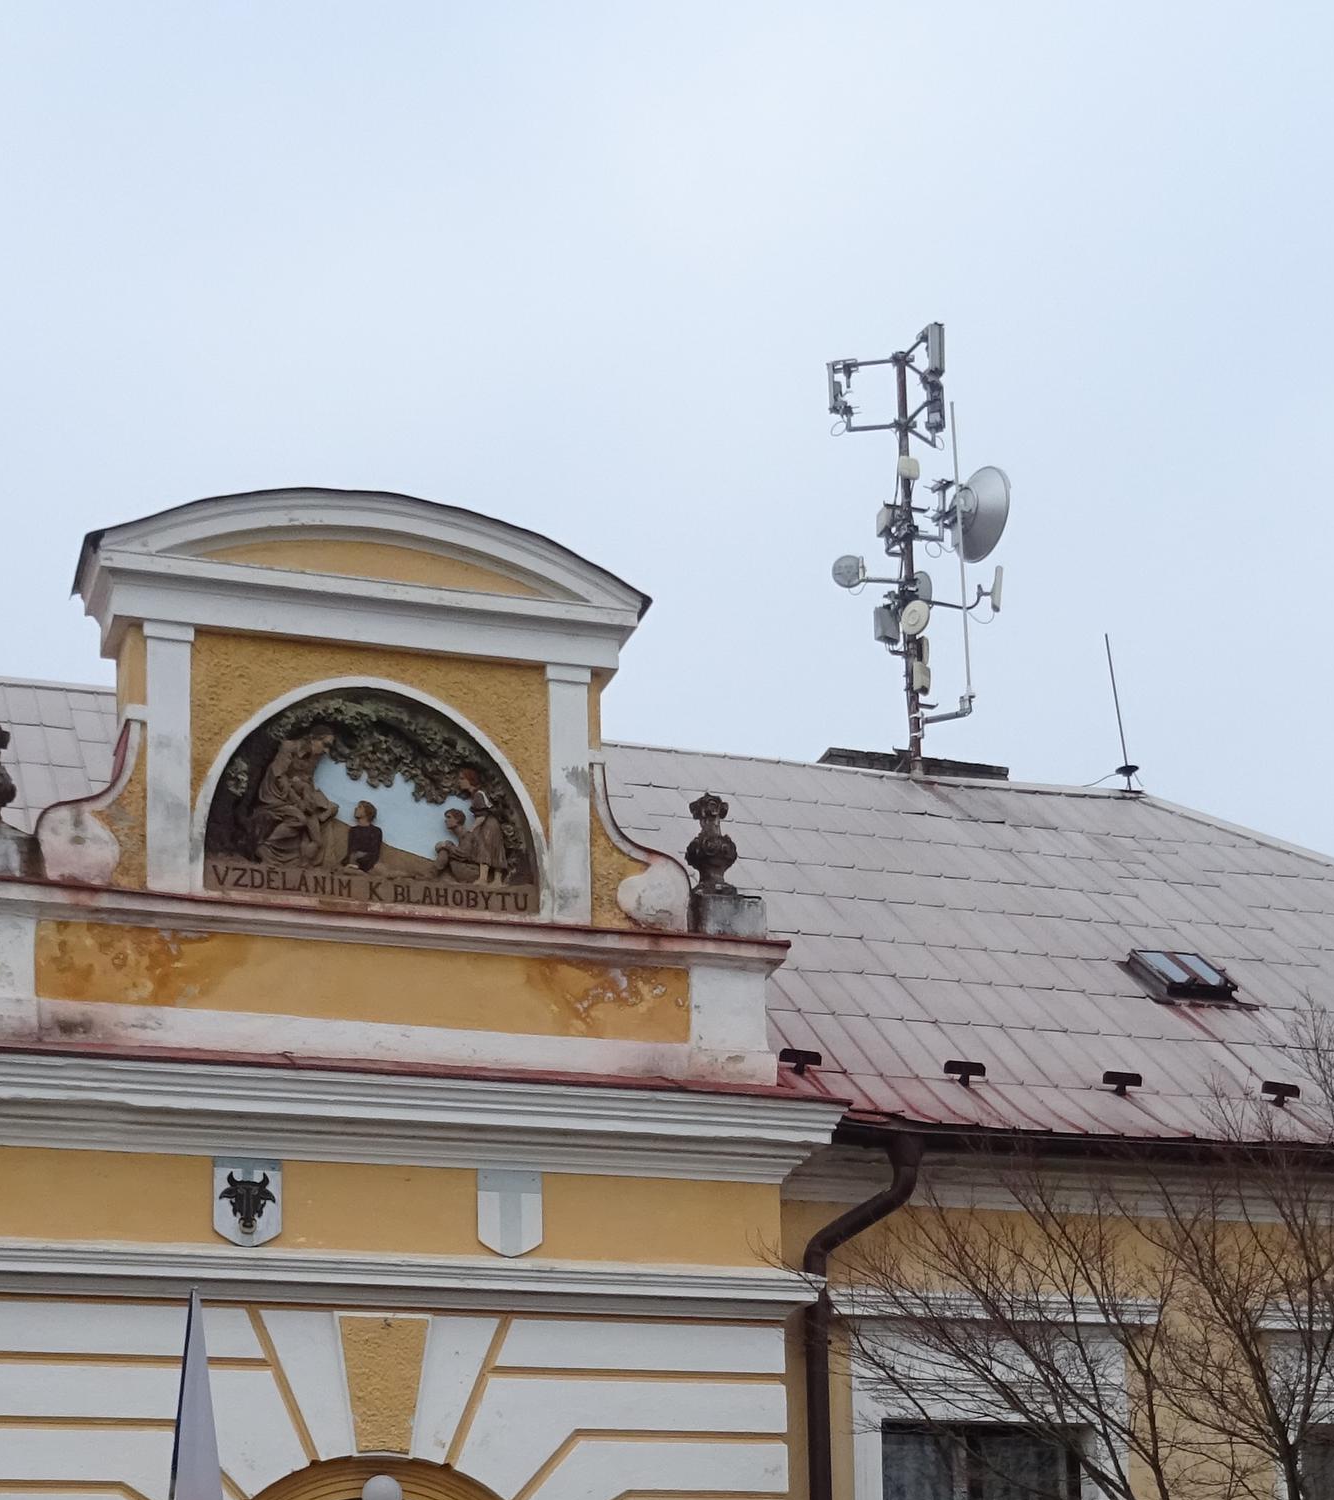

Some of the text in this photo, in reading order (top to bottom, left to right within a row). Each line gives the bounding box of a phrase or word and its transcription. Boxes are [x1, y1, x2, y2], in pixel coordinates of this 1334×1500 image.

[212, 865, 529, 912] VZDĚLÁNÍM K BLAHOBYTU
